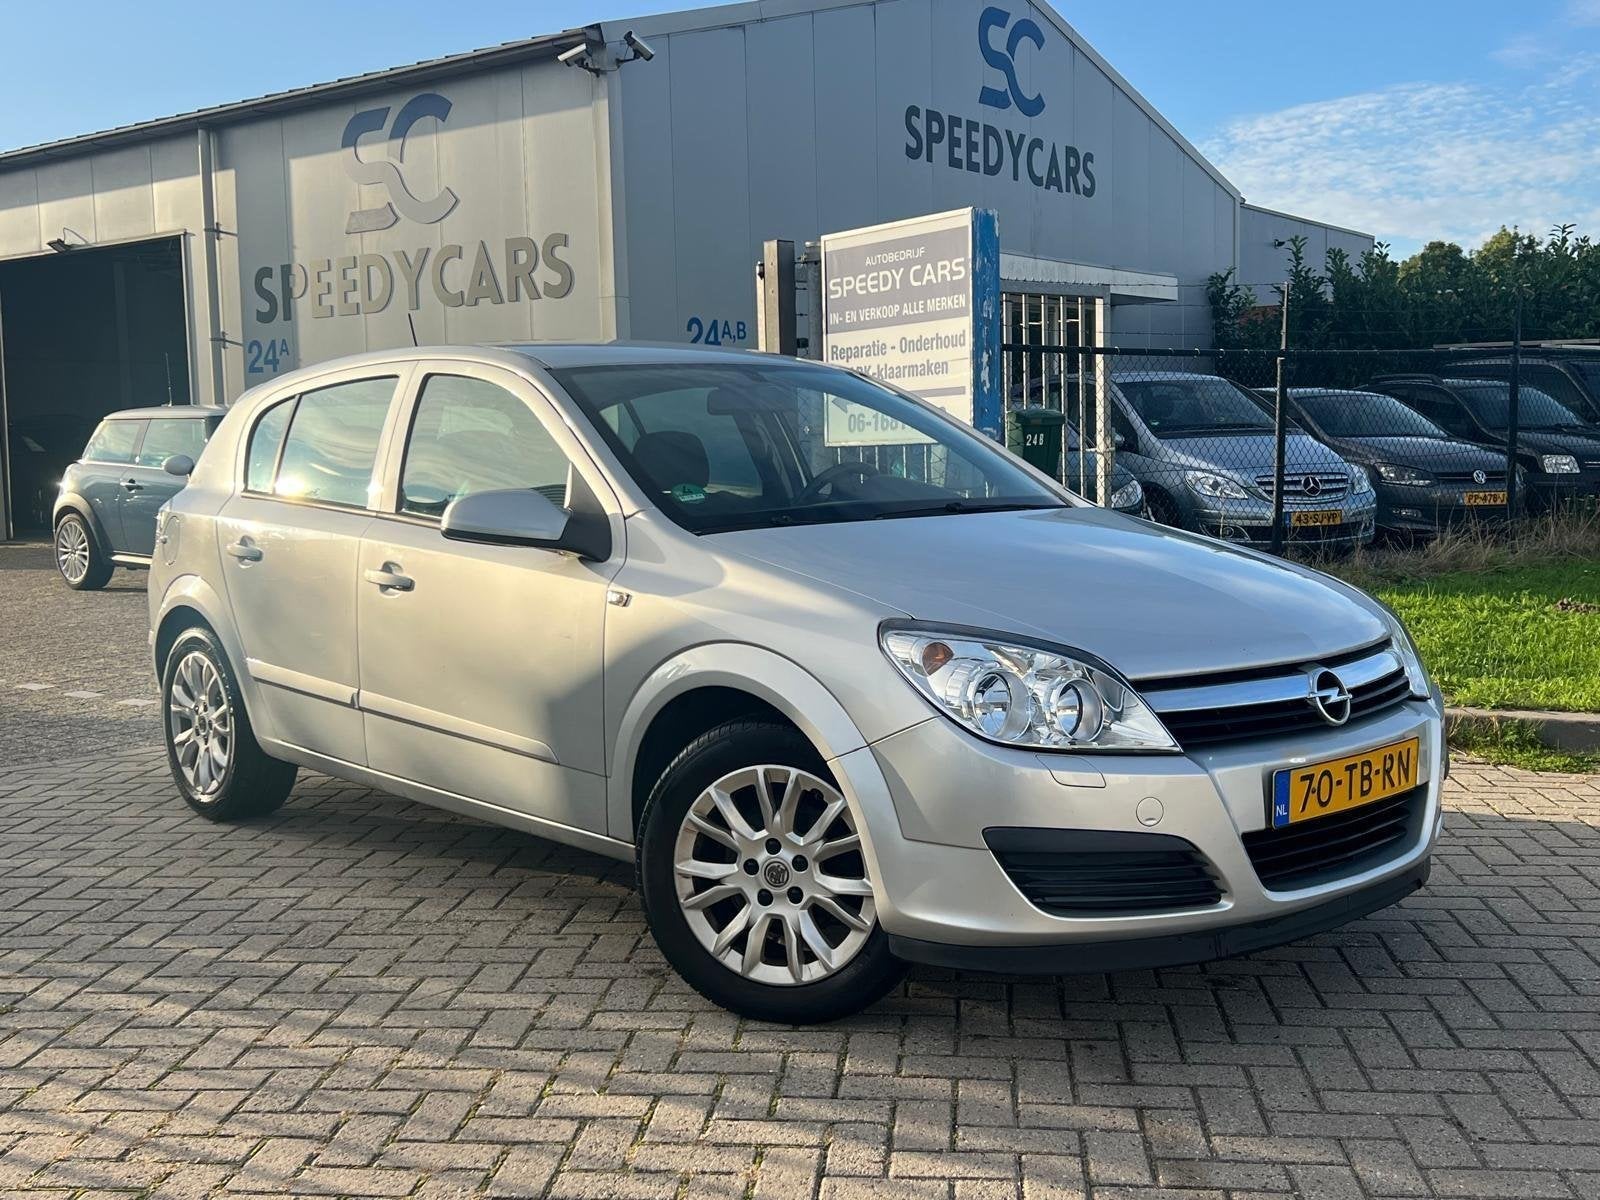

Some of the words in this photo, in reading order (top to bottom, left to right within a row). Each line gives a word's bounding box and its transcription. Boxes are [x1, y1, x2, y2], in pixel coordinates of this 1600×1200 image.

[904, 104, 1096, 198] SPEEDYCARS
[865, 246, 926, 266] AUTOBEDRIJF
[254, 232, 575, 324] SPEEDYCARS
[829, 267, 904, 299] SPEEDY
[909, 257, 966, 287] CARS
[829, 311, 843, 325] IN-
[845, 310, 857, 323] EN
[859, 304, 900, 321] VERKOOP
[902, 300, 924, 316] ALLE
[927, 293, 966, 312] MERKEN
[831, 340, 887, 363] Reparatie
[899, 329, 966, 354] Onderhoud
[1276, 804, 1288, 817] NL
[1299, 747, 1411, 813] 70-TB-RN
